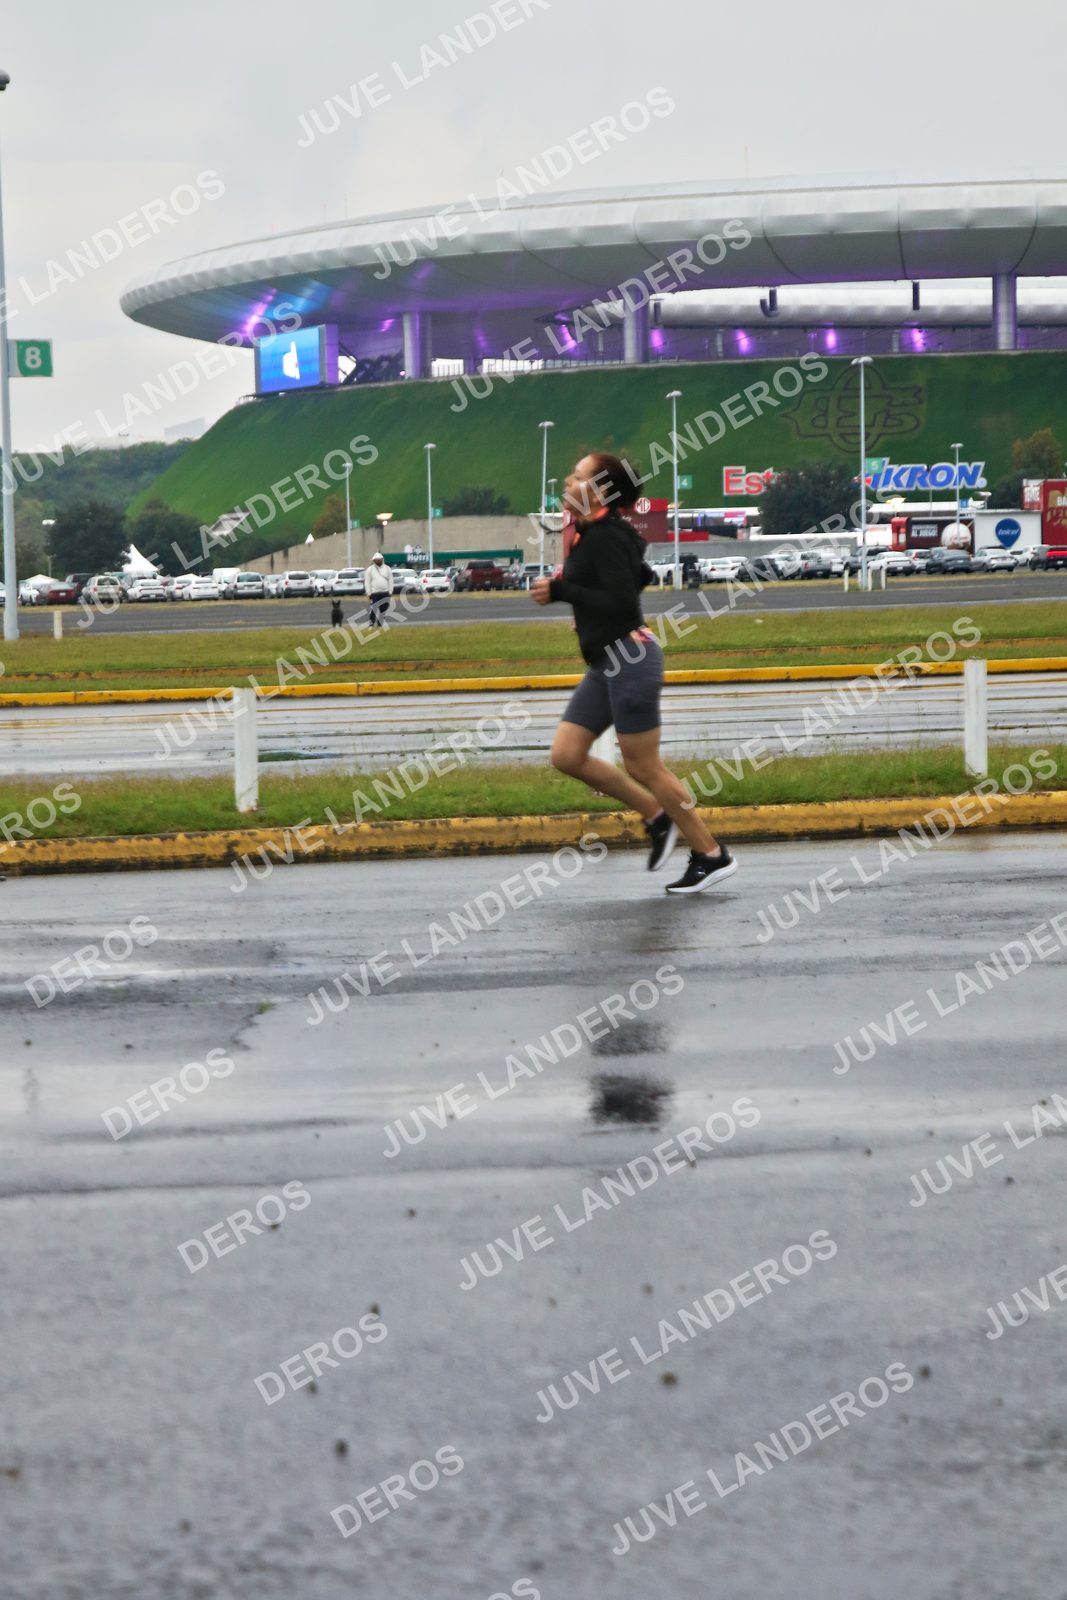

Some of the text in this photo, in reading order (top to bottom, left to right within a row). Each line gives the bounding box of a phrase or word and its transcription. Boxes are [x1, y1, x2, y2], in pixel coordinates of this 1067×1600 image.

[25, 346, 42, 369] 8
[872, 460, 879, 470] 5
[681, 478, 688, 487] 4
